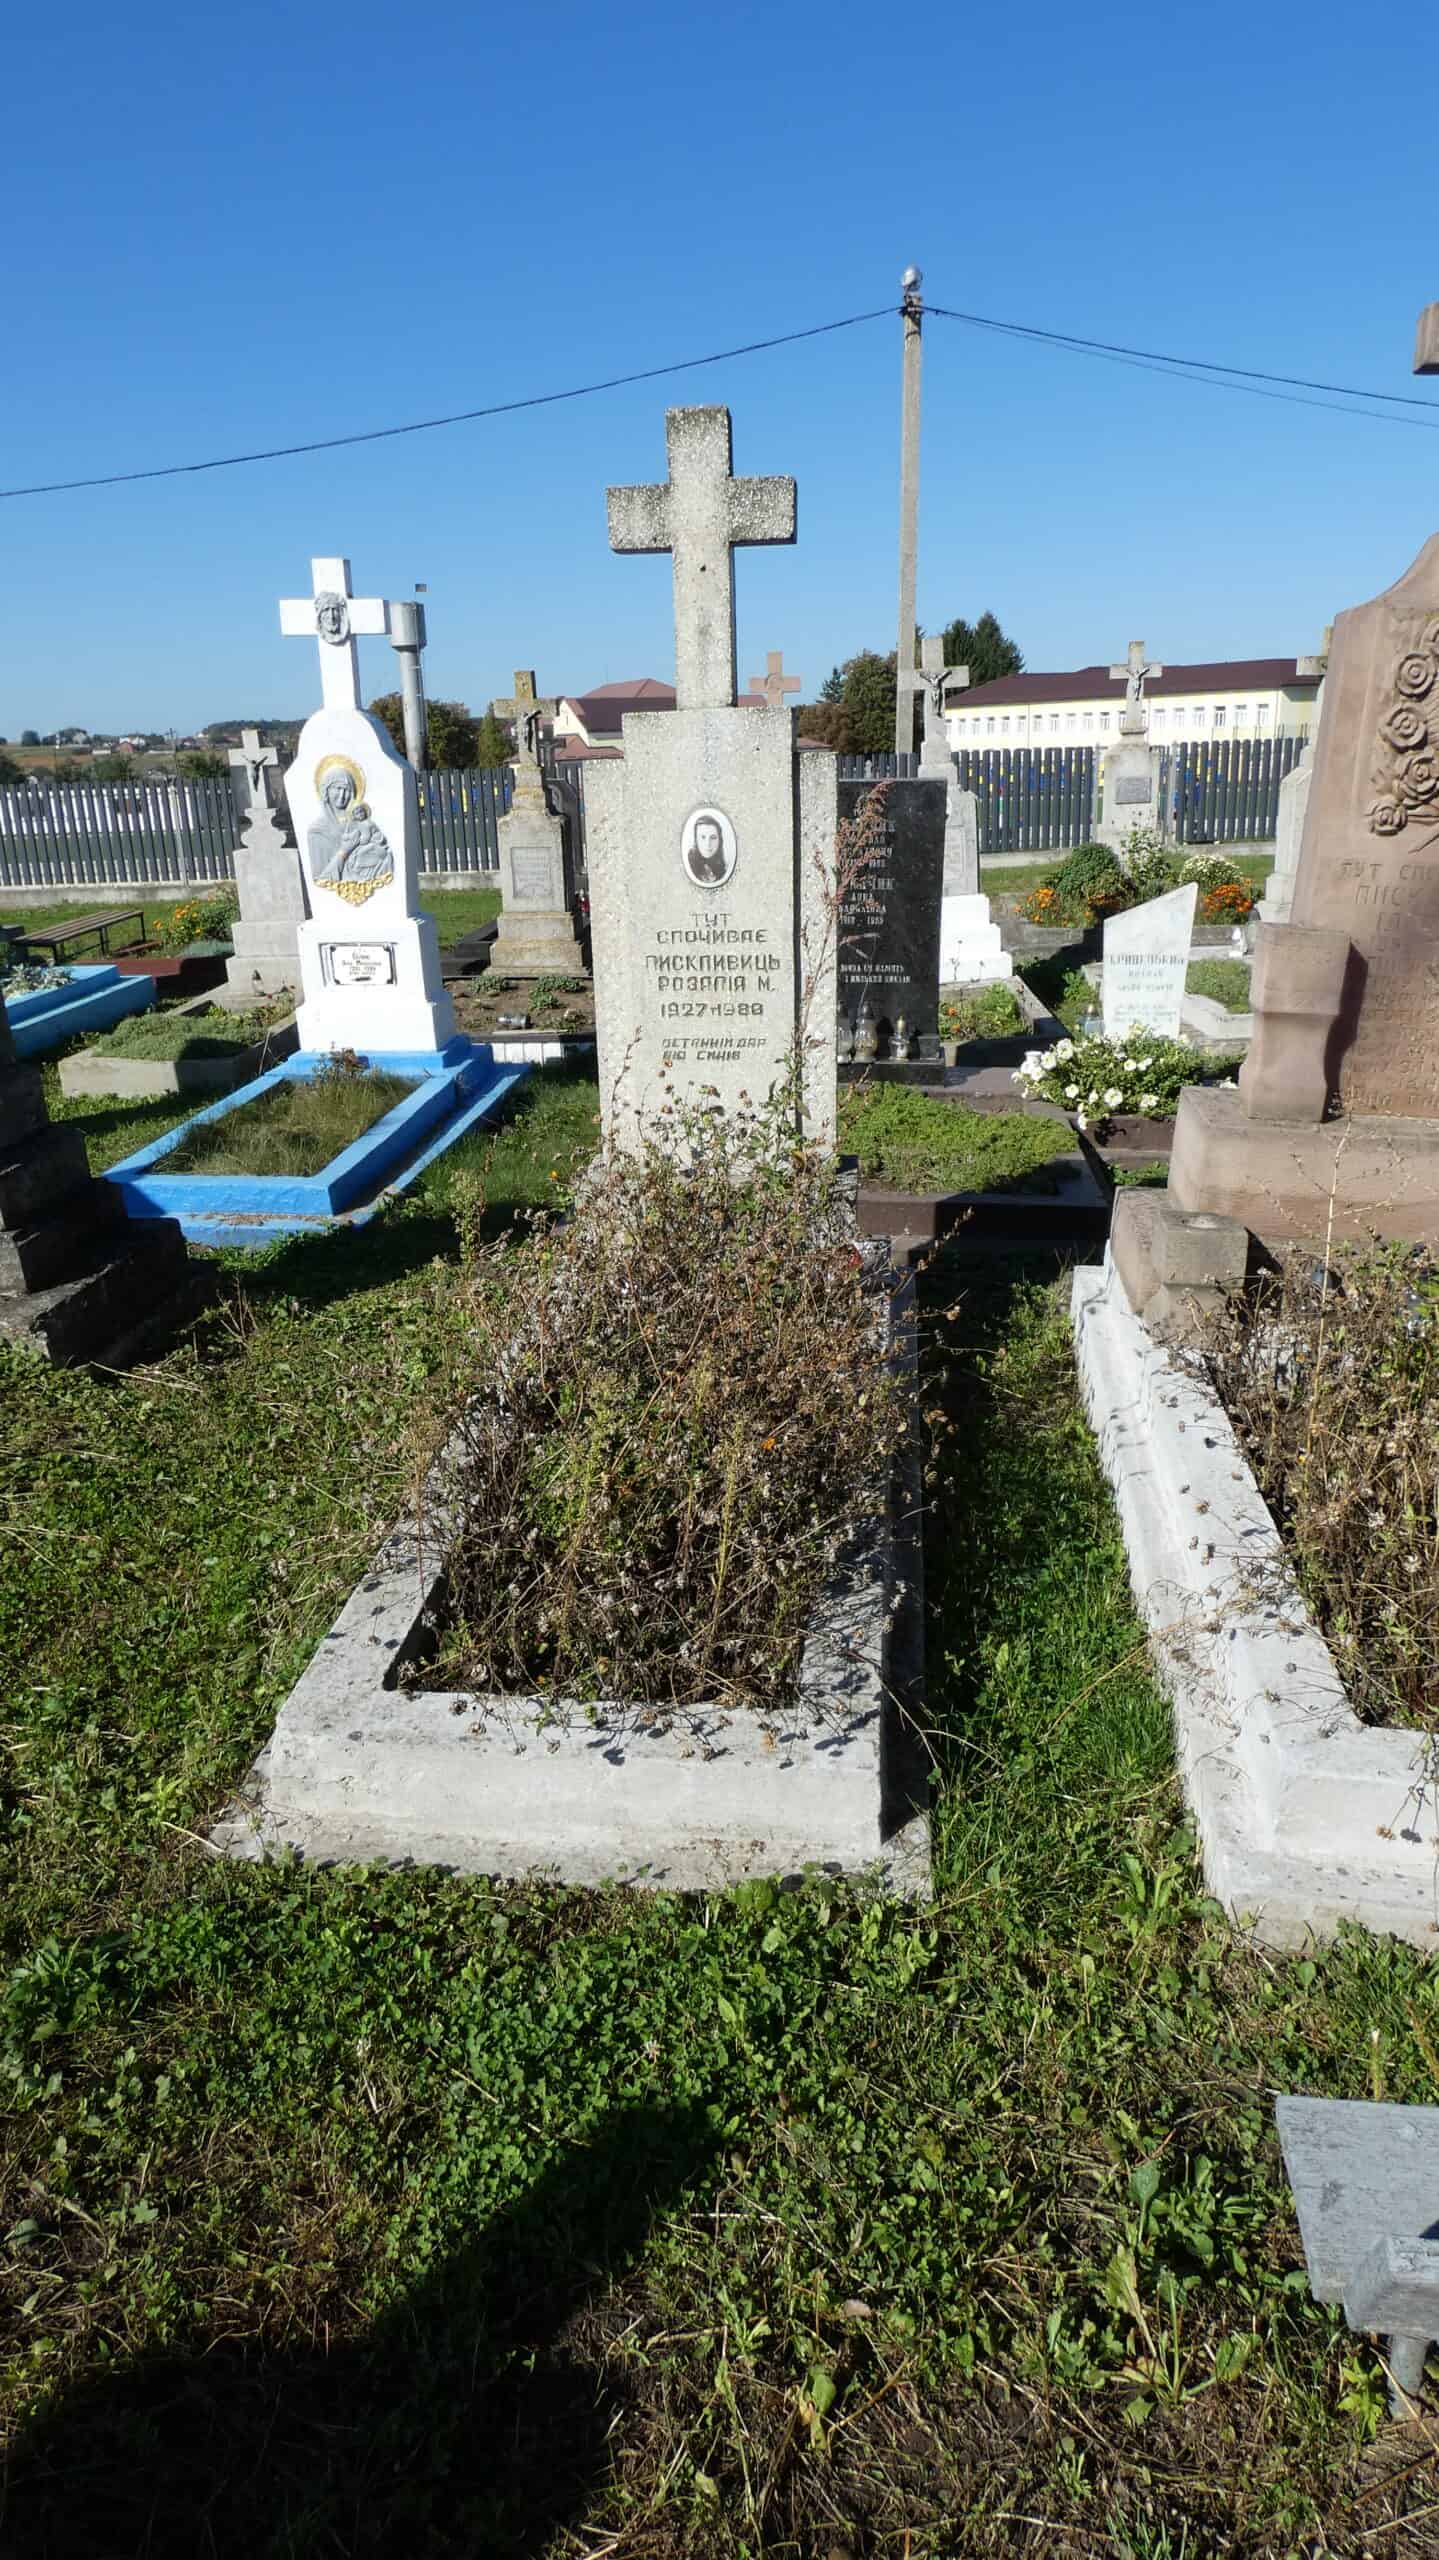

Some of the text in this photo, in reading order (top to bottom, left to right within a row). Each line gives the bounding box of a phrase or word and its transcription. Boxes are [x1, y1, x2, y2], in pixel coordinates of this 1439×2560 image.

[689, 912, 732, 929] ТУТ
[656, 929, 769, 945] СПОЧИВАЄ
[662, 1037, 768, 1049] ОСТАННІЙ ДАР
[696, 1050, 742, 1062] СИНІВ
